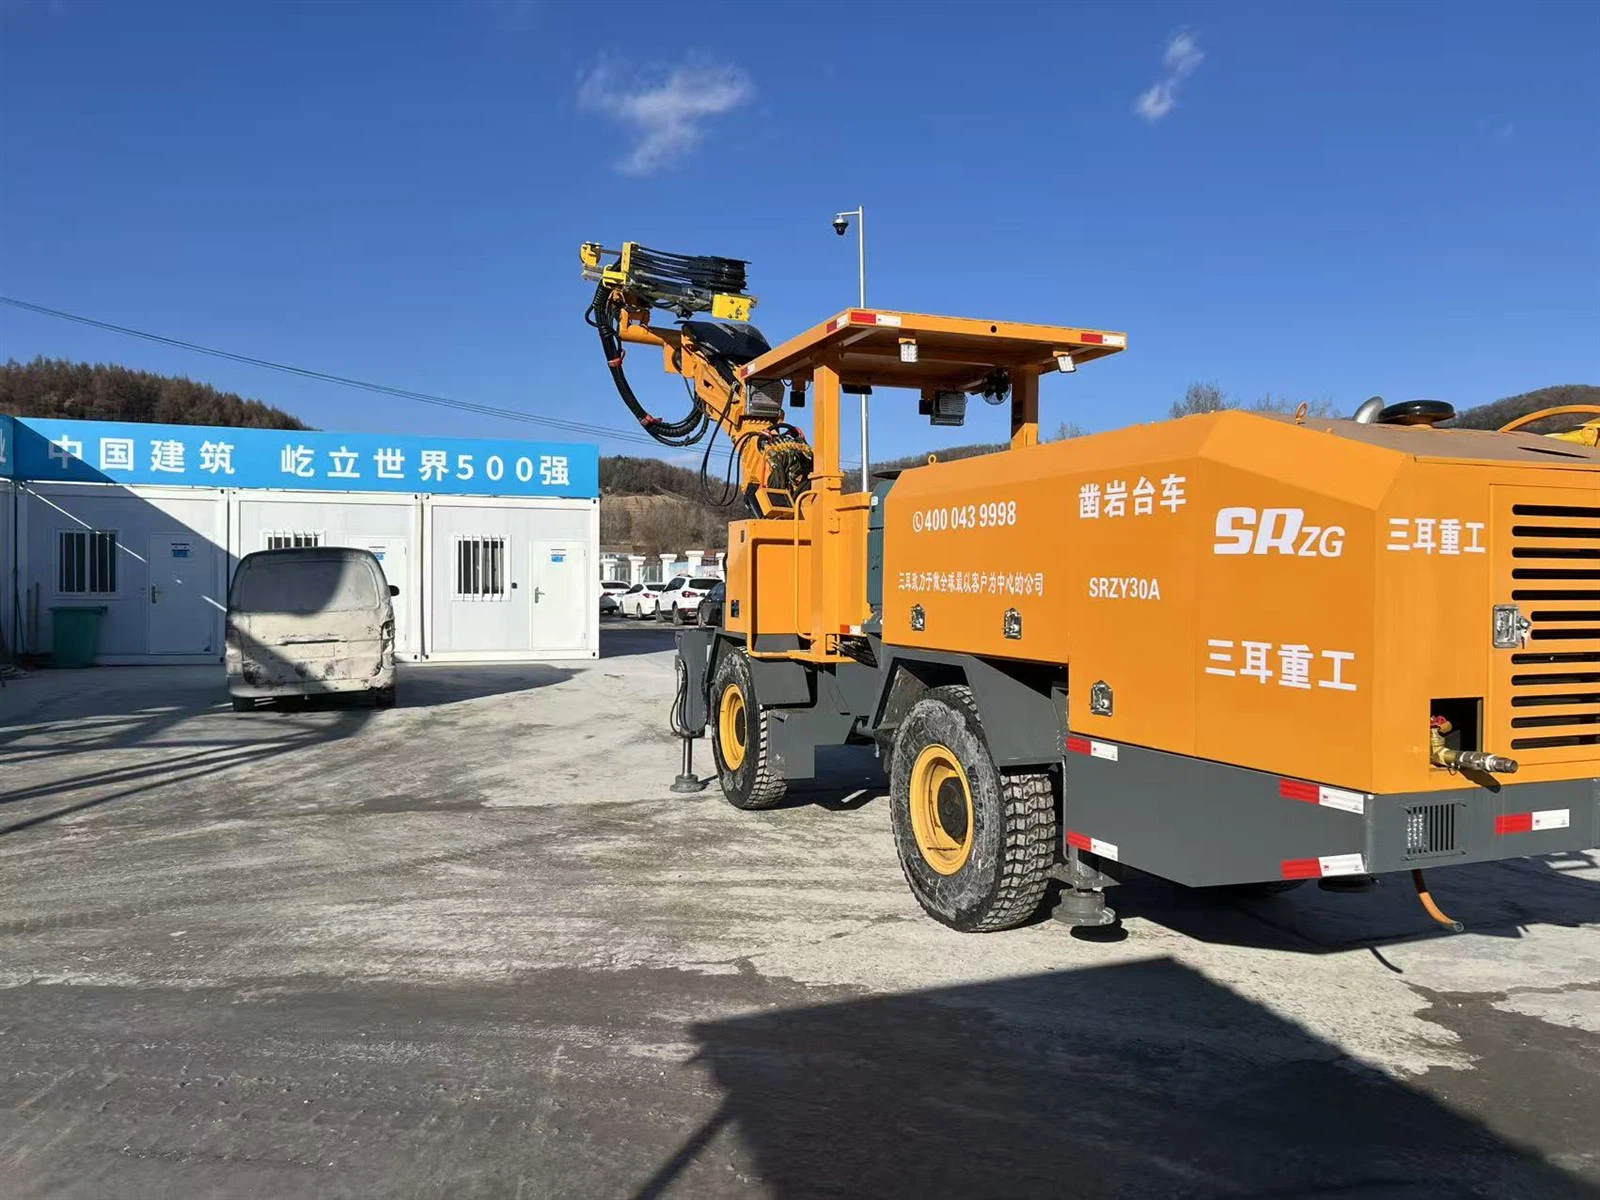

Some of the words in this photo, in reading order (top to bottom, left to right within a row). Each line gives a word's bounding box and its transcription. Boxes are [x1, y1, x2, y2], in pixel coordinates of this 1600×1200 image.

[48, 435, 236, 475] 中国建筑
[280, 444, 571, 487] 屹立世界500强
[924, 509, 948, 532] 400
[950, 505, 976, 530] 043
[978, 500, 1017, 528] 9998
[1078, 473, 1187, 519] 凿岩台车
[1386, 517, 1487, 556] 三耳重工
[1088, 576, 1162, 601] SRZY30A
[1204, 638, 1358, 692] 三耳重工
